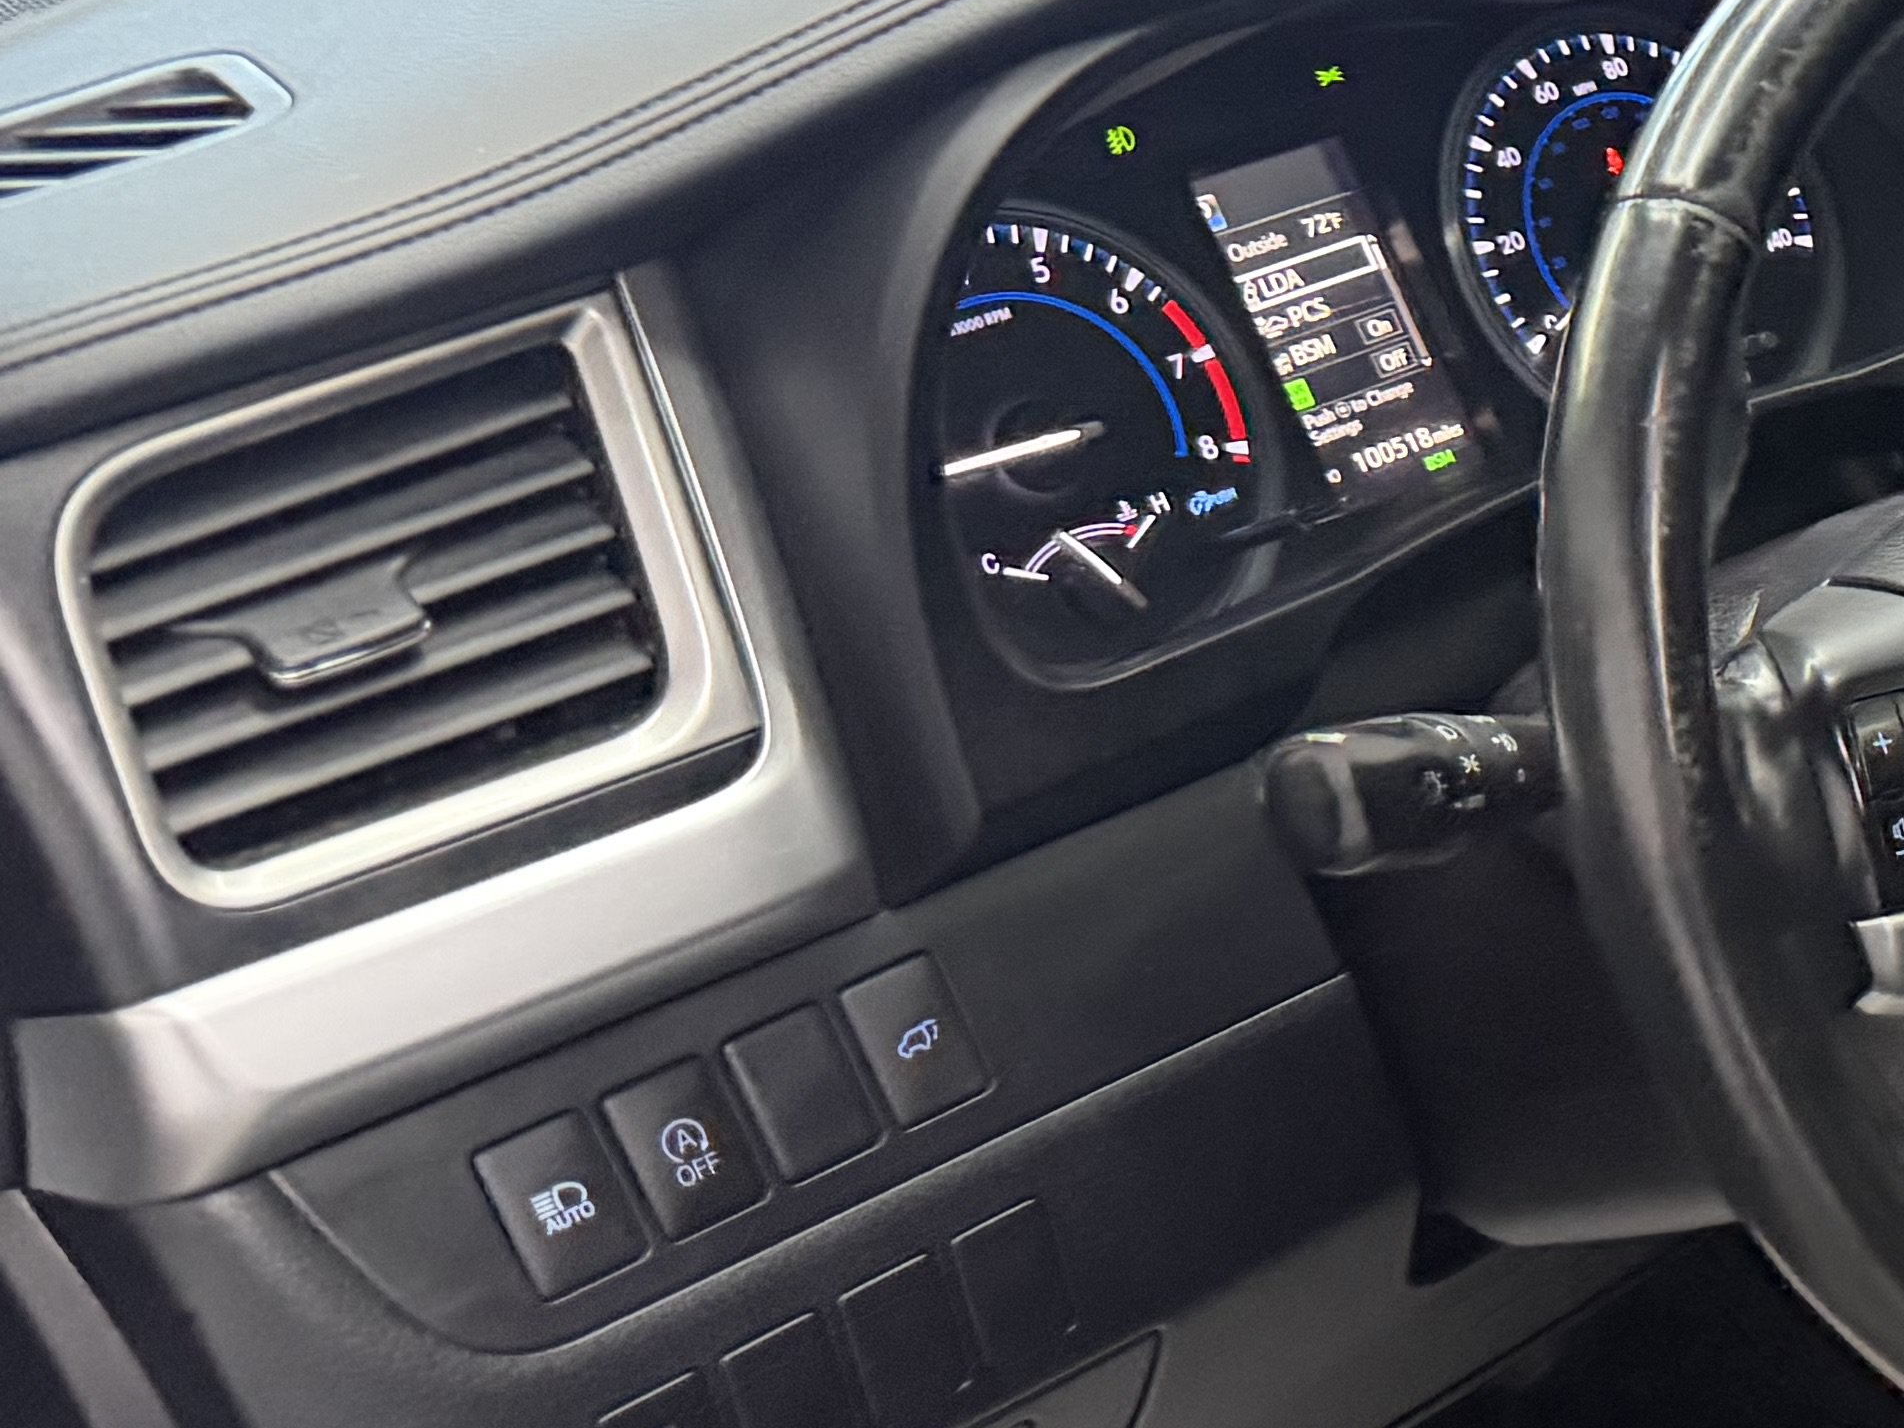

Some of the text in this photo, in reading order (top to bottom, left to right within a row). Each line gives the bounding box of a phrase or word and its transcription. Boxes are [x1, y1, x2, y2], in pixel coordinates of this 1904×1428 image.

[1601, 56, 1630, 81] 80
[1533, 81, 1561, 106] 60
[1496, 146, 1523, 170] 40
[1226, 231, 1290, 263] Outside
[1495, 230, 1526, 256] 20
[1030, 255, 1051, 284] 5
[1256, 268, 1306, 299] LDA
[1109, 287, 1130, 315] 6
[1285, 296, 1332, 328] PCS
[983, 306, 1014, 329] RPM
[1289, 318, 1394, 367] BSM On
[1165, 352, 1185, 381] 7
[1379, 347, 1410, 372] Off
[1301, 381, 1415, 431] Push to Change
[1199, 434, 1220, 461] 8
[1307, 419, 1364, 448] Settings
[1351, 423, 1465, 473] 100518 miles
[1149, 490, 1172, 512] H
[676, 1150, 720, 1188] OFF
[545, 1199, 597, 1236] AUTO
